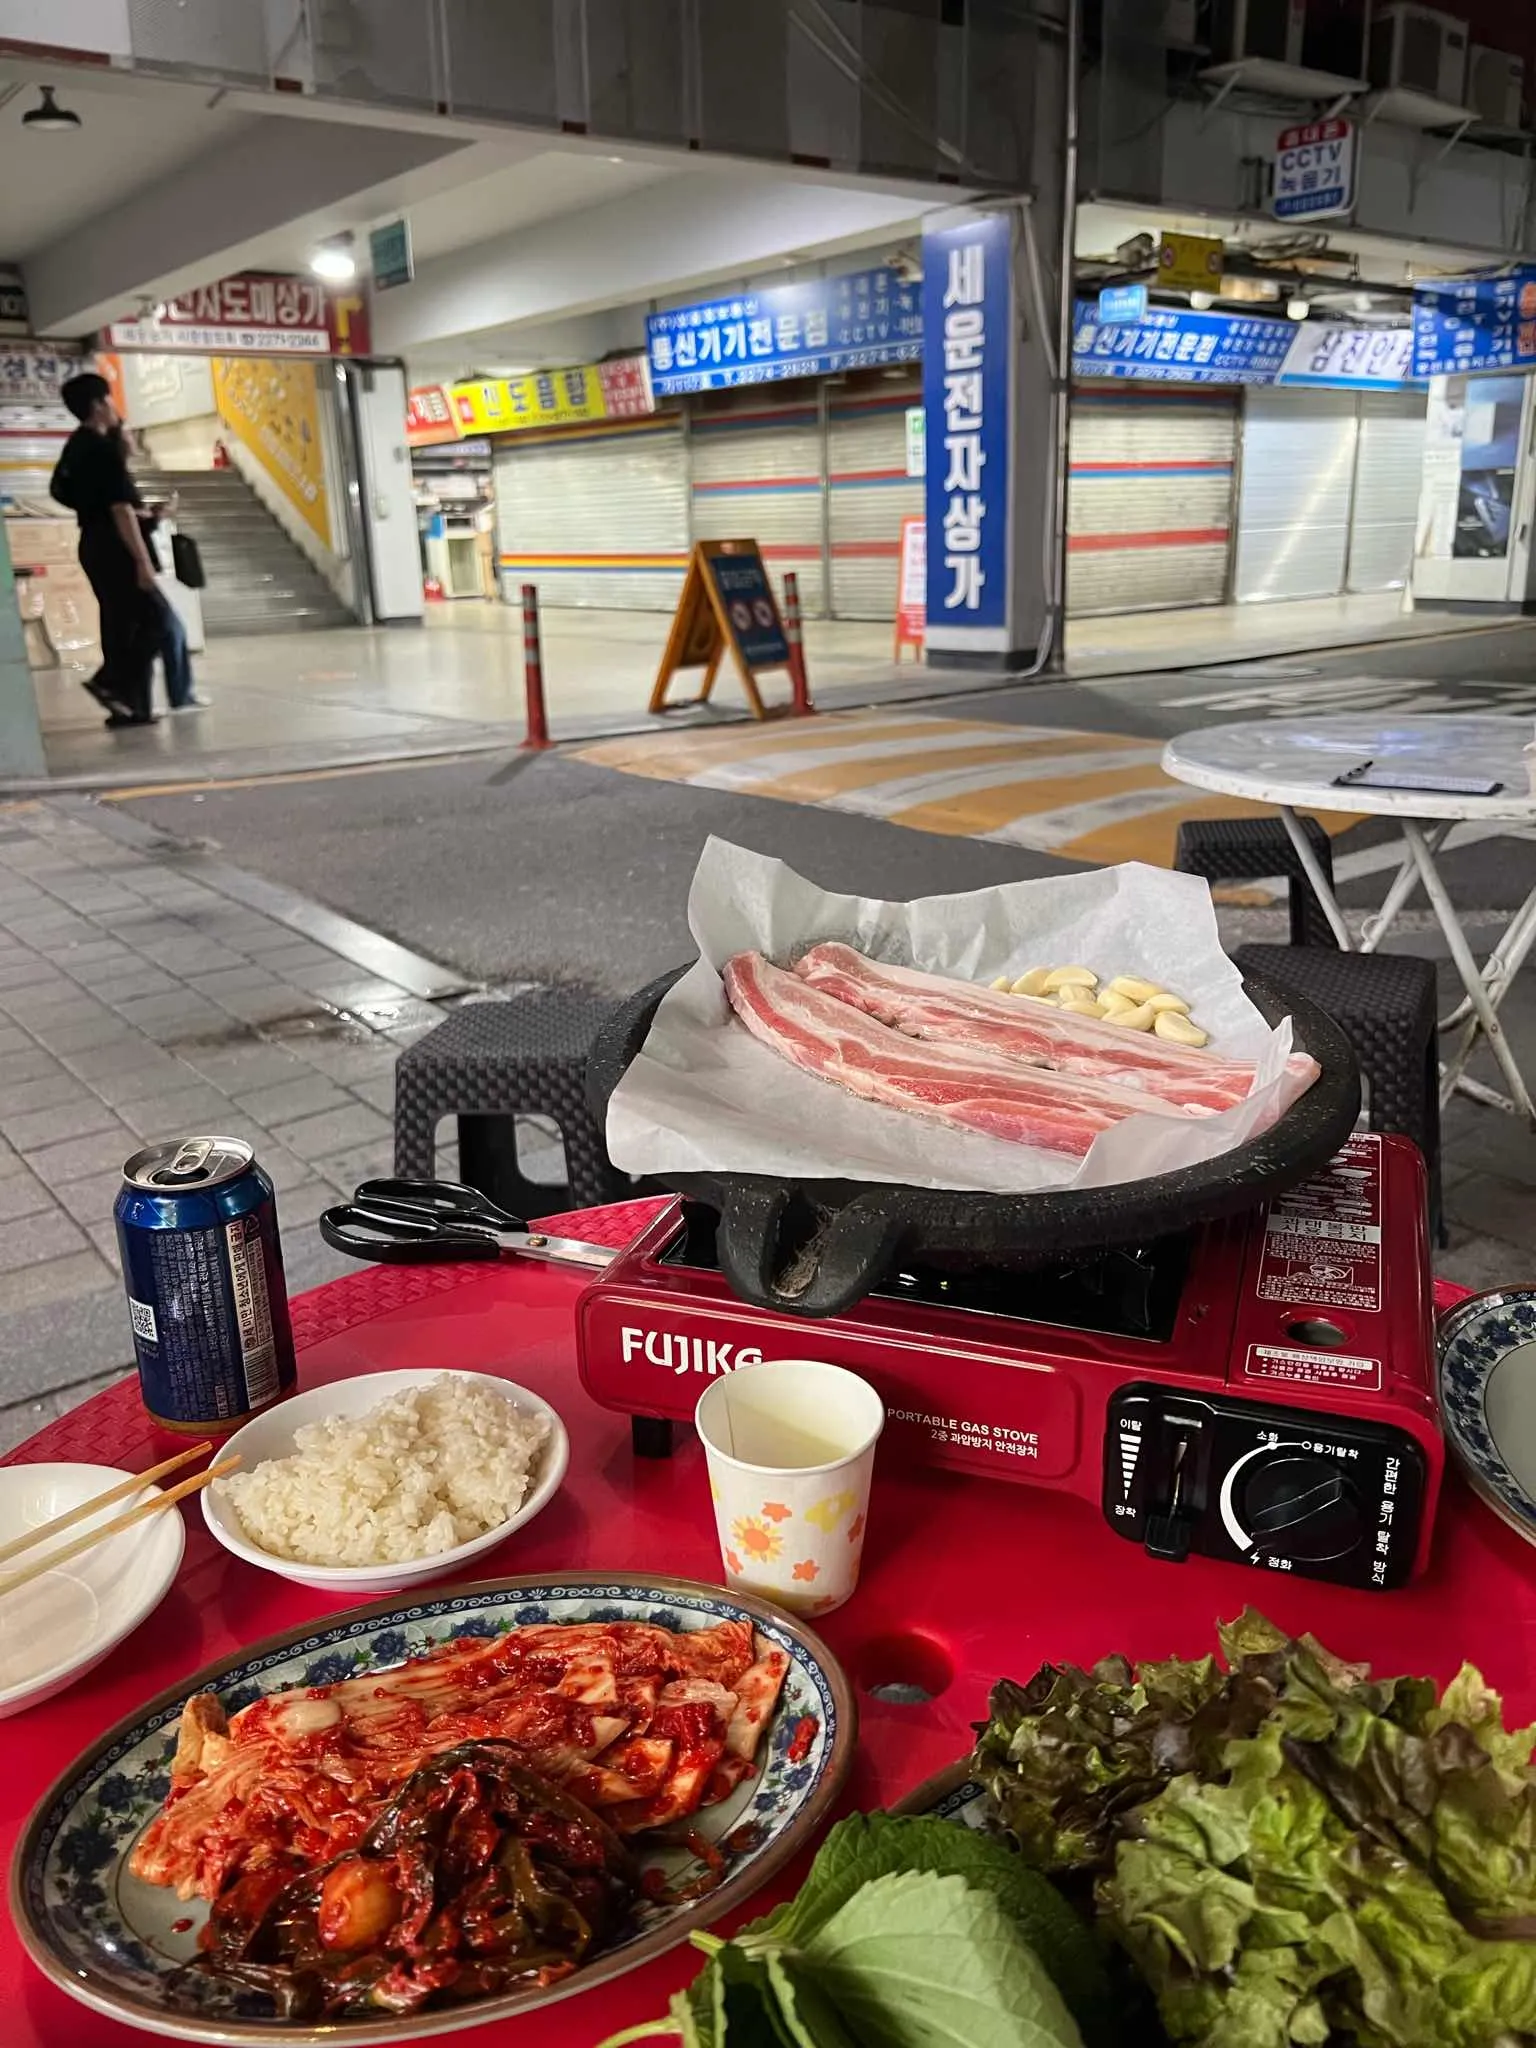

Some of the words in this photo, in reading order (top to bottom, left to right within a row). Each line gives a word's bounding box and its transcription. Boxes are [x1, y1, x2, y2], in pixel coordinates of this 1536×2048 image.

[1281, 142, 1343, 171] CCTV
[1279, 166, 1341, 192] 녹음기
[651, 309, 829, 371] 통신기기전문점
[943, 244, 986, 610] 세운전자상가
[234, 1261, 251, 1308] 청소년에게
[887, 1407, 958, 1429] PORTABLE
[961, 1421, 990, 1436] GAS
[993, 1426, 1039, 1445] STOVE
[1120, 1418, 1142, 1431] 이탈
[1256, 1430, 1278, 1442] 소화
[931, 1429, 949, 1441] 2중
[950, 1432, 992, 1450] 과압방지
[995, 1440, 1038, 1459] 안전장치
[1313, 1442, 1359, 1459] 용기탈착
[1384, 1457, 1400, 1495] 간편한
[1115, 1504, 1137, 1518] 장착
[1379, 1500, 1394, 1525] 용기
[1376, 1530, 1390, 1555] 탈착
[1268, 1555, 1292, 1571] 점화
[1371, 1560, 1387, 1584] 방식
